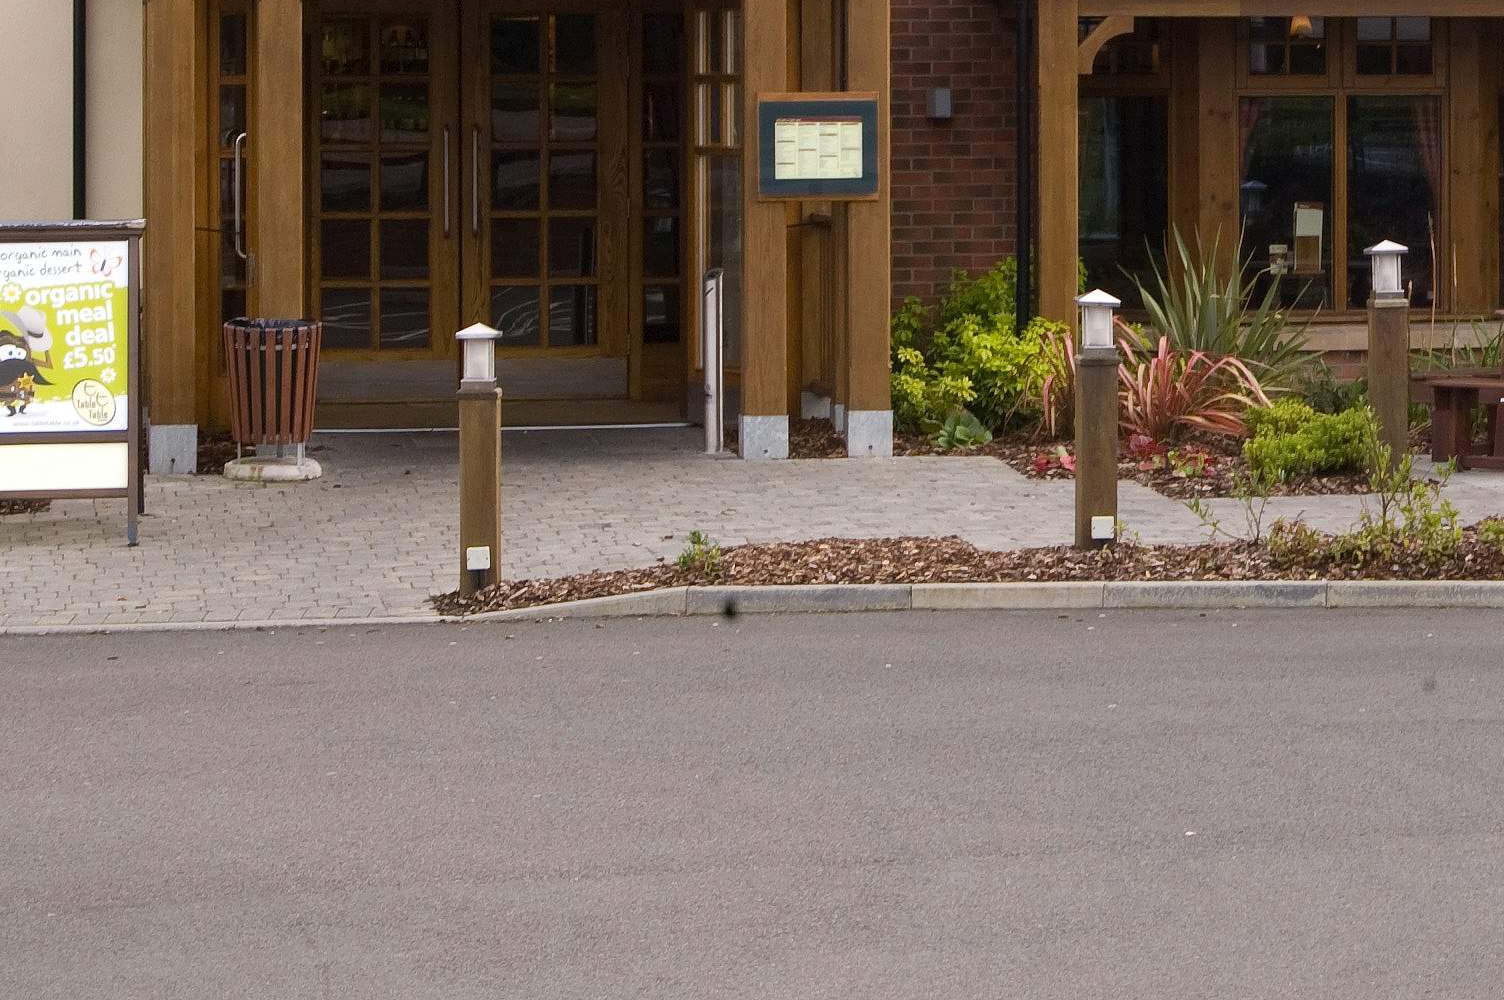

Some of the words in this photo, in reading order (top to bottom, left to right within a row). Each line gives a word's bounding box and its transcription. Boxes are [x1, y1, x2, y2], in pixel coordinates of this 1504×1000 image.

[0, 246, 47, 265] organic
[52, 244, 82, 257] main
[0, 264, 36, 283] ganic
[40, 260, 83, 276] dessert
[25, 283, 113, 308] organic
[56, 300, 113, 325] meal
[65, 321, 115, 346] deal
[77, 399, 96, 409] Table
[89, 409, 108, 419] Table
